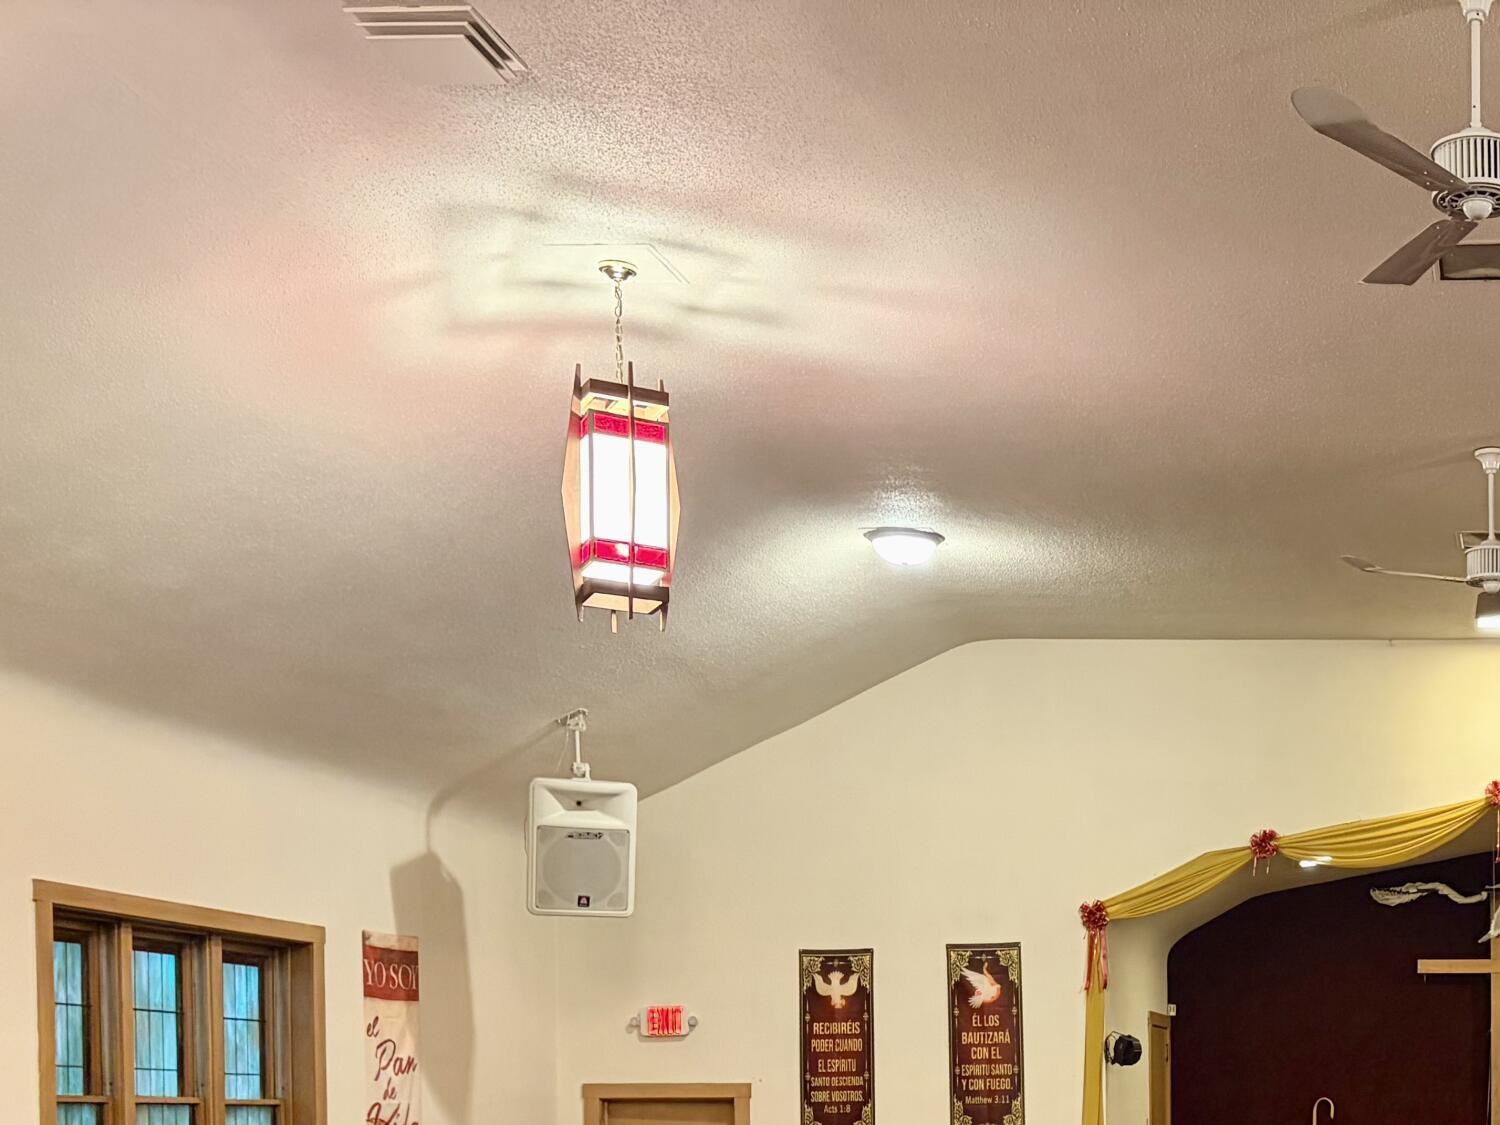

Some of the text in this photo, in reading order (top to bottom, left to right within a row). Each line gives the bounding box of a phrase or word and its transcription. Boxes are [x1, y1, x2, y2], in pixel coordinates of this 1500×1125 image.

[363, 958, 387, 988] YO
[366, 1015, 379, 1038] el
[647, 1007, 683, 1035] EXIT
[813, 1019, 861, 1035] RECIBIRÉIS
[972, 1012, 1000, 1027] ÉL LOS
[961, 1028, 1011, 1044] BAUTIZARÁ
[811, 1038, 863, 1052] PODER CUANDO
[374, 1038, 418, 1081] Pan
[971, 1046, 1003, 1060] CON EL
[817, 1057, 857, 1073] EL ESPÍRITU
[990, 1063, 1013, 1076] SANTO
[810, 1075, 864, 1087] SANTO DESCIENDA
[961, 1077, 1014, 1091] Y CON FUEGO.
[383, 1077, 397, 1101] de
[810, 1090, 865, 1103] SOBRE VOSOTROS.
[965, 1095, 1010, 1105] Matthew 3:11
[823, 1104, 851, 1114] Acts 1:8
